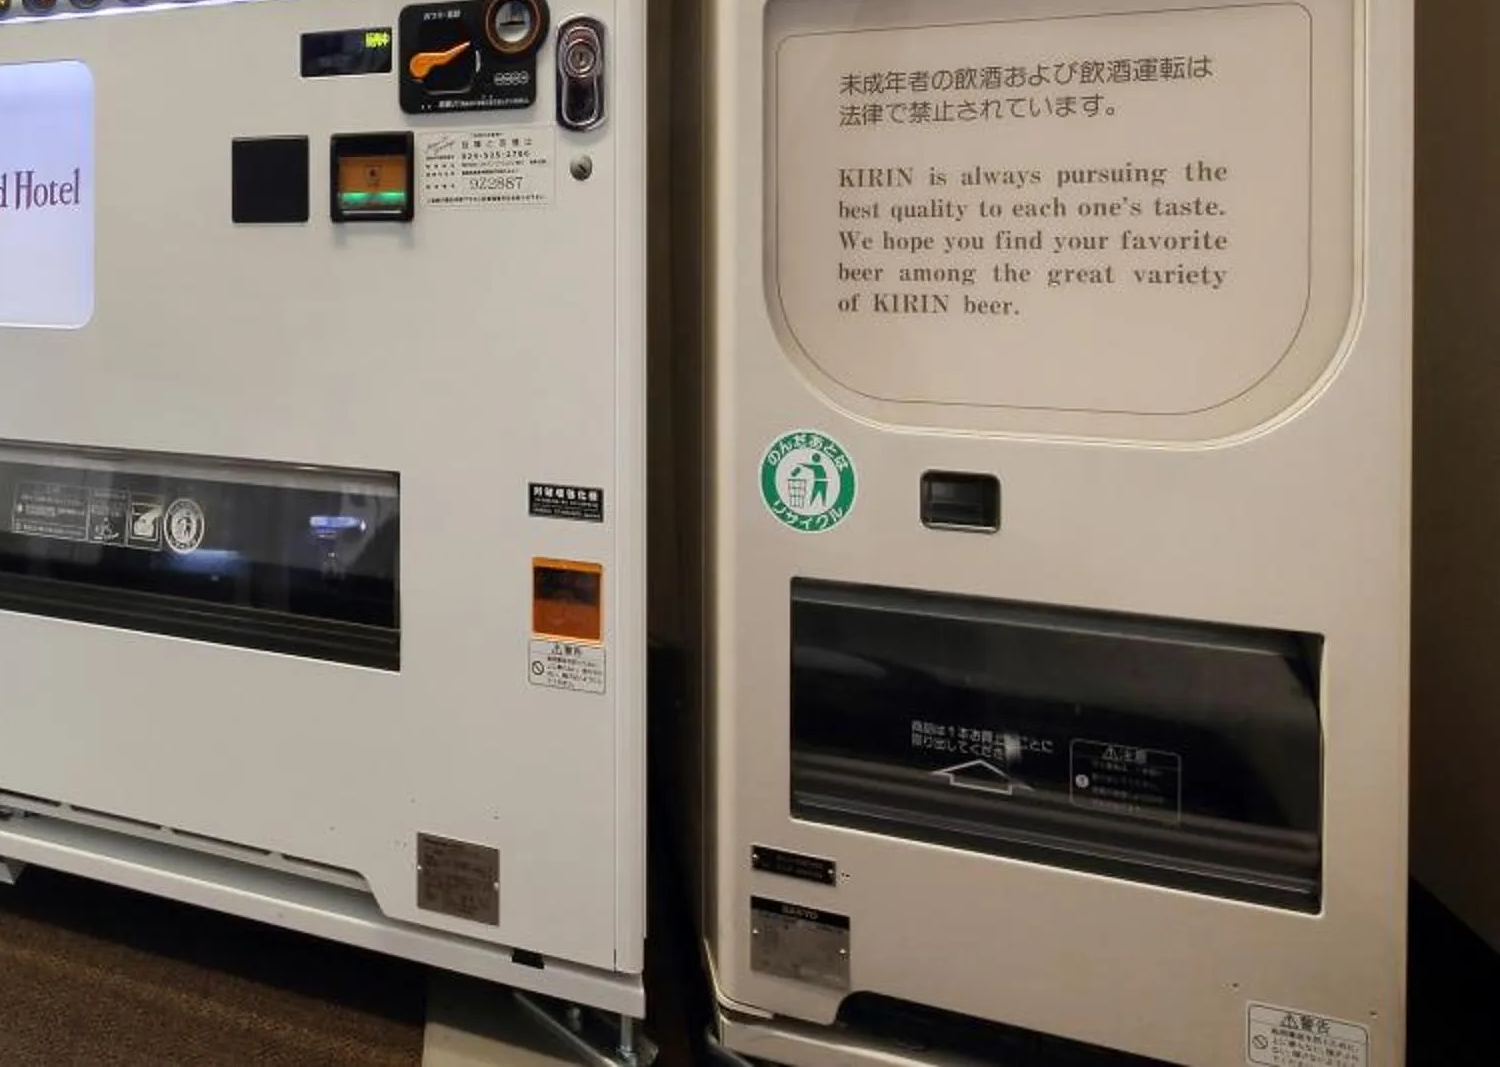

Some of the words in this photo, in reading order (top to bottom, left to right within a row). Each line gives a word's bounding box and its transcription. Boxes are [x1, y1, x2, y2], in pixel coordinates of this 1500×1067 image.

[839, 56, 1214, 95] 未成年者の飲酒および飲酒運転は
[839, 93, 1116, 127] 法律で禁止されています。
[15, 168, 81, 211] Hotel
[839, 167, 913, 189] KIRIN
[929, 166, 947, 187] is
[961, 165, 1041, 190] always
[1057, 163, 1168, 188] pursuing
[1185, 160, 1227, 183] the
[838, 200, 879, 220] best
[890, 198, 967, 223] quality
[979, 200, 1003, 218] to
[1011, 196, 1067, 218] each
[1077, 196, 1142, 217] one's
[1154, 196, 1226, 216] taste.
[839, 230, 873, 251] We
[883, 230, 935, 254] hope
[944, 236, 984, 254] you
[995, 230, 1042, 251] find
[1053, 235, 1109, 254] your
[1122, 229, 1228, 251] favorite
[838, 262, 884, 283] beer
[899, 267, 976, 287] among
[993, 263, 1031, 283] the
[1047, 265, 1114, 287] great
[1133, 263, 1227, 290] variety
[837, 293, 861, 313] of
[874, 293, 949, 314] KIRIN
[963, 294, 1020, 315] beer.
[766, 434, 850, 472] のんだあとは
[771, 498, 845, 530] リサイクル
